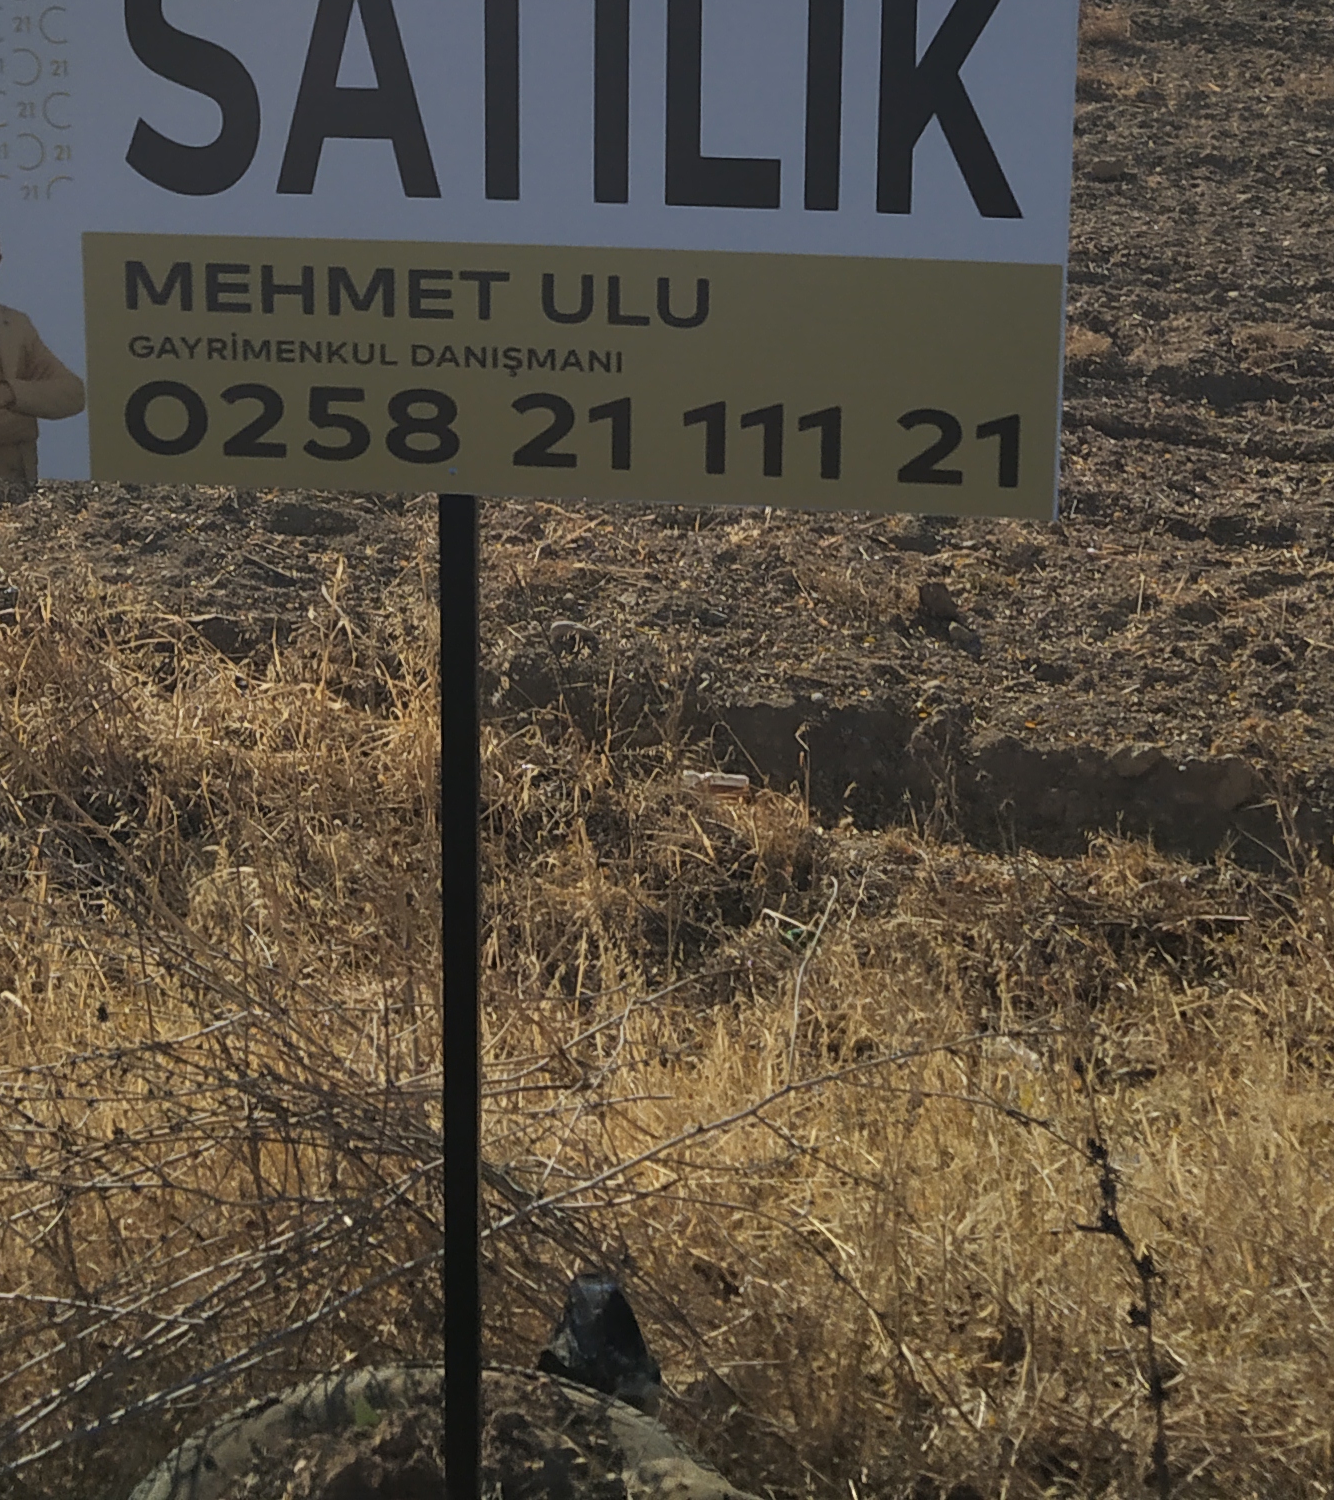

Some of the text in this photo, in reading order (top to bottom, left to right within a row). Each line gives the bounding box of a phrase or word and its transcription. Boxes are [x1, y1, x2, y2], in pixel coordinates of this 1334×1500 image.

[124, 260, 710, 328] MEHMET ULU
[128, 332, 623, 378] GAYRİMENKUL DANIŞMANI
[124, 380, 1022, 488] 0258 21 111 21
